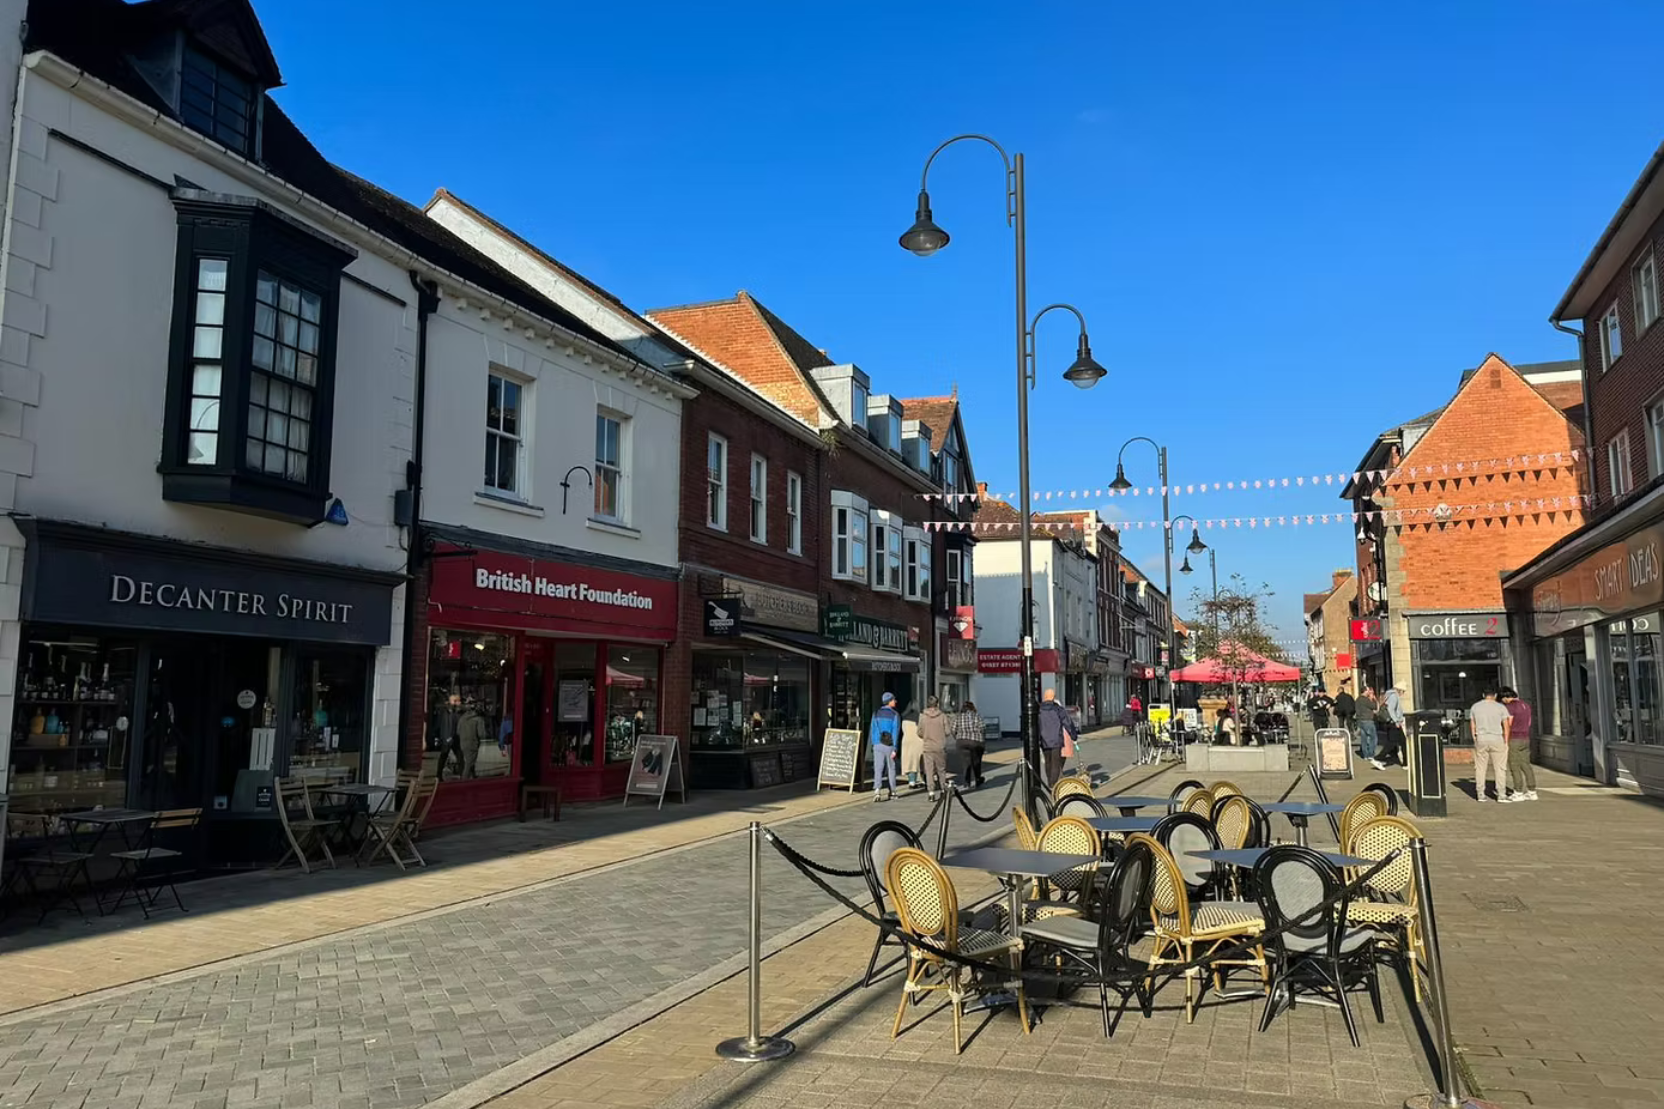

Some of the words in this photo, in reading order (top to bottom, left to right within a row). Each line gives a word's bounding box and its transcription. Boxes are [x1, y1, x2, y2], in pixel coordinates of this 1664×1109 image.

[475, 568, 532, 595] British
[534, 577, 577, 600] Heart
[579, 584, 653, 610] Foundation
[1594, 557, 1624, 601] SMART
[1627, 544, 1660, 588] IDEAS
[109, 574, 267, 616] DECANTER
[277, 593, 354, 624] SPIRIT
[1485, 617, 1498, 635] 2
